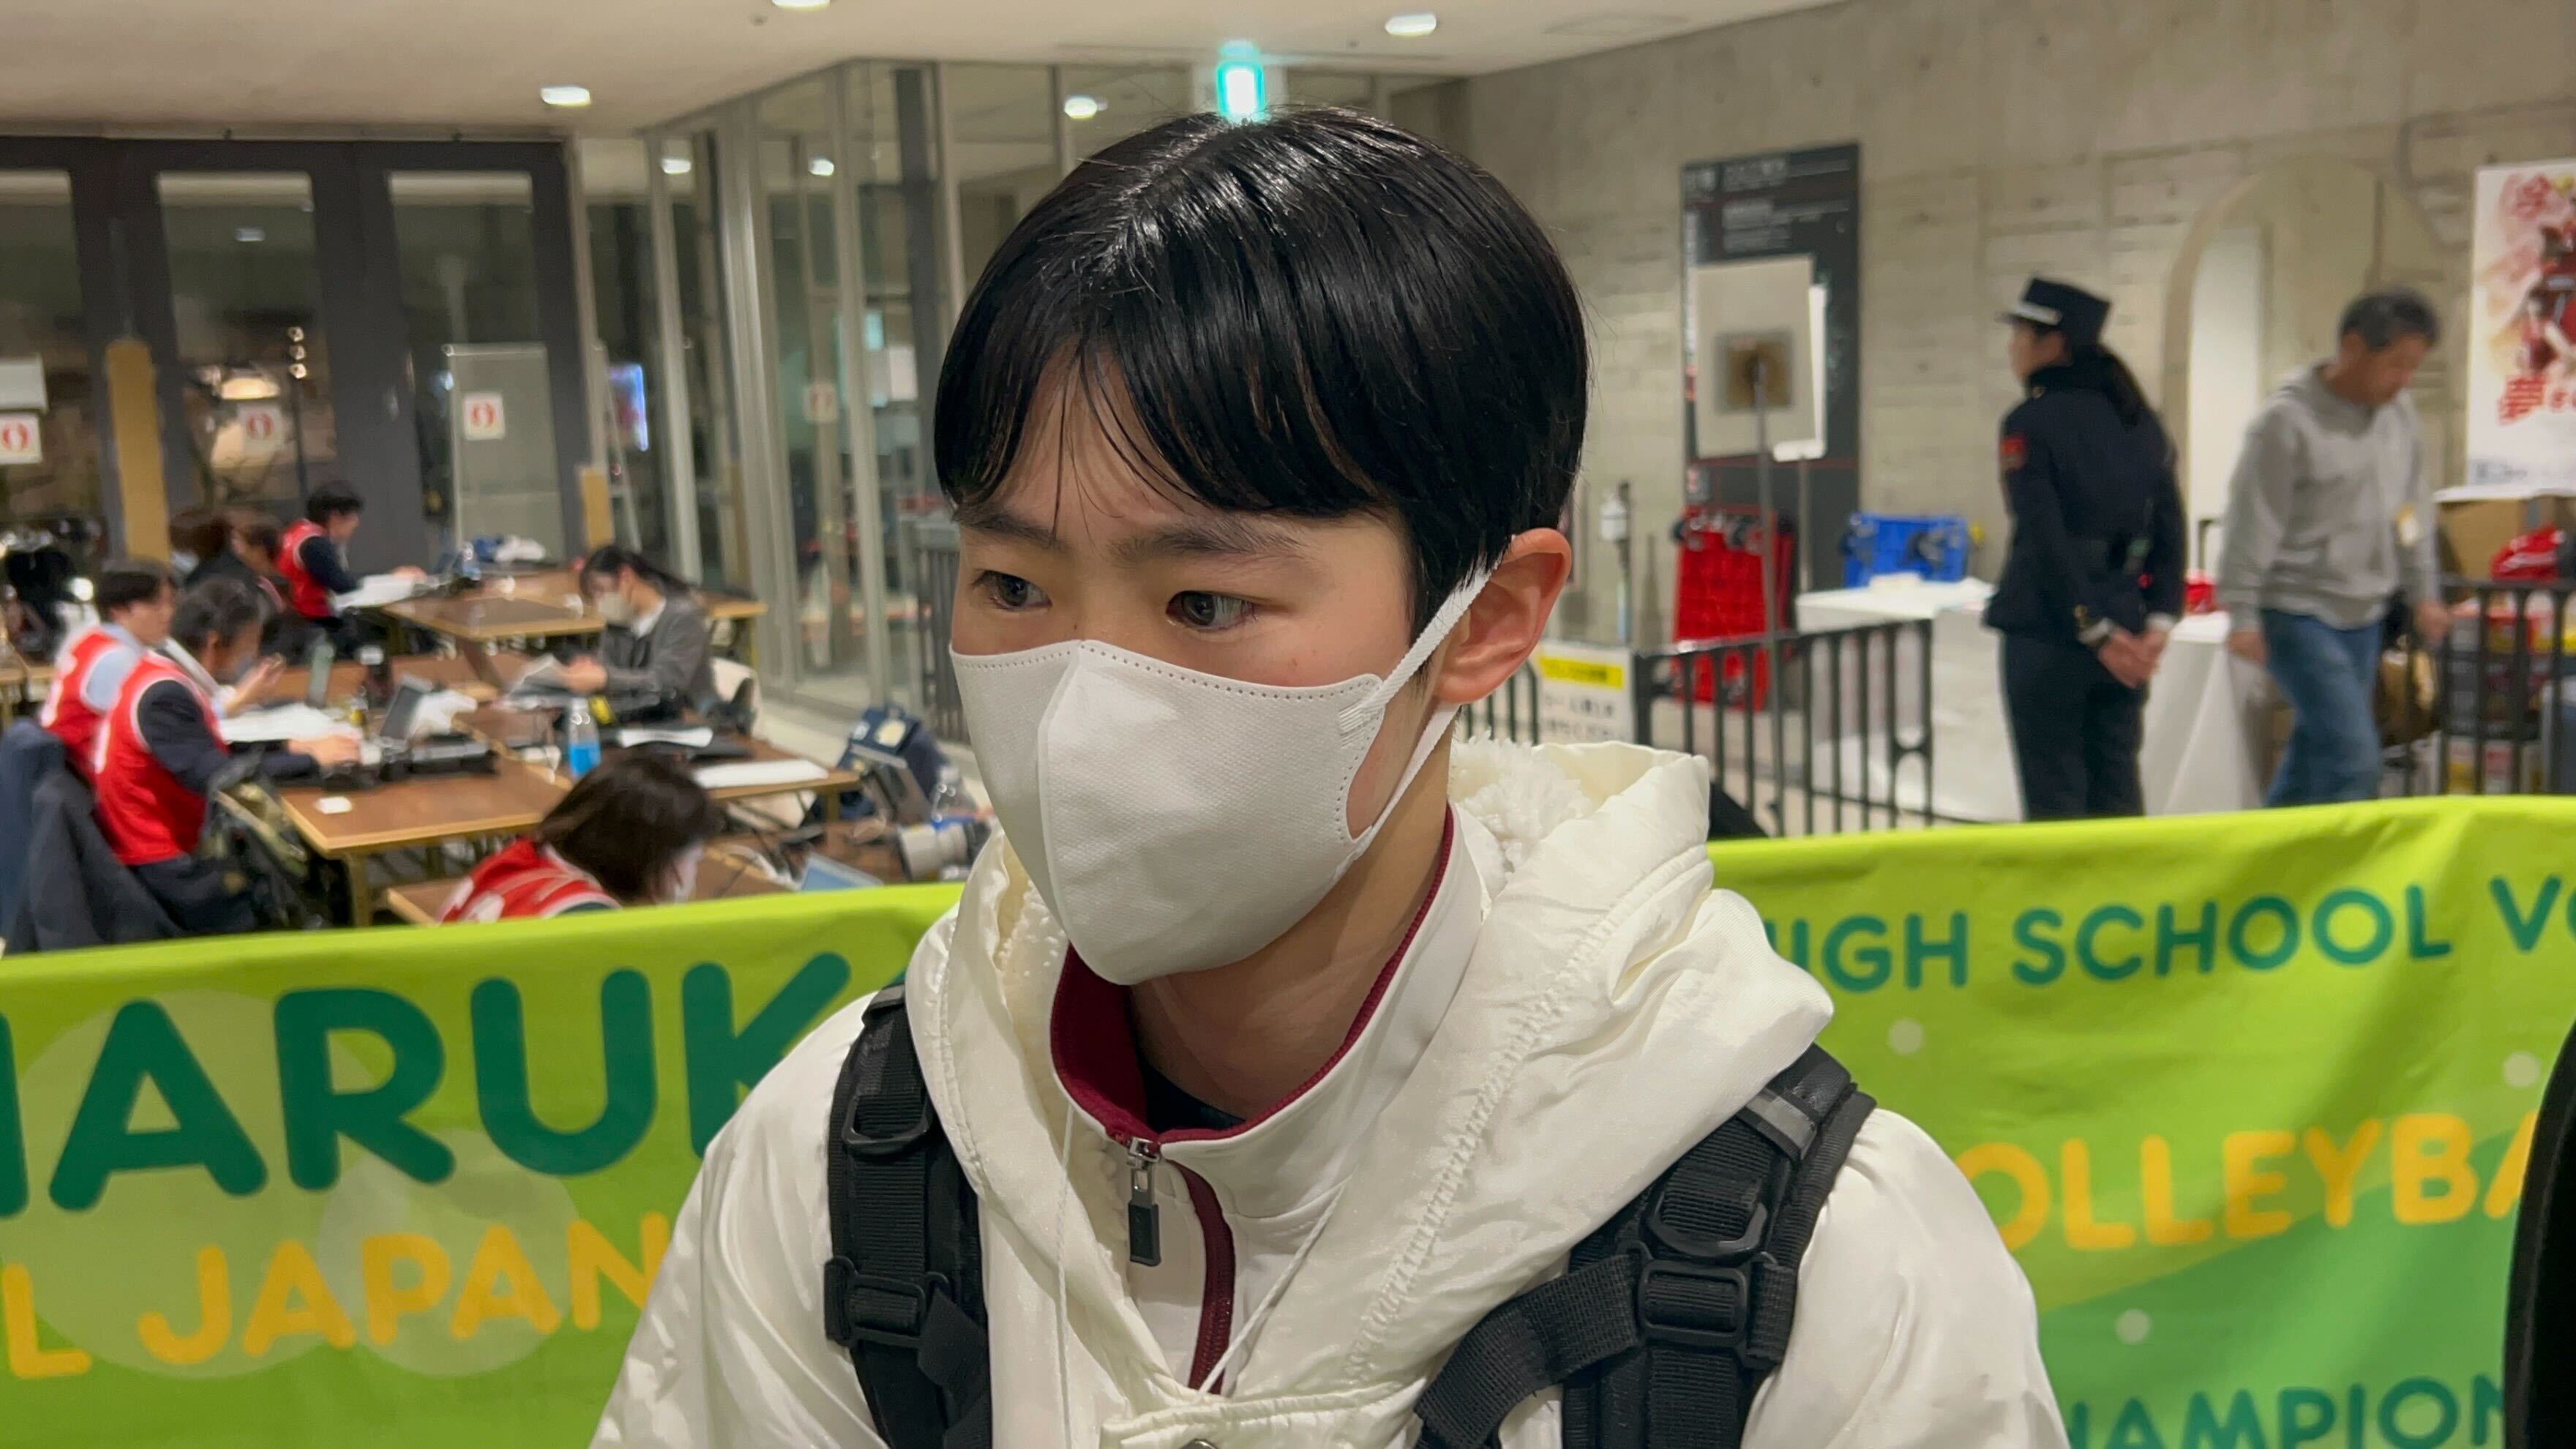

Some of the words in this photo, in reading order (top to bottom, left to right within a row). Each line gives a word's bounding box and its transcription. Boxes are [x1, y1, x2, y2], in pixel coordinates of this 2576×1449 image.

[1763, 910, 1969, 993] IGH
[2012, 884, 2452, 986] SCHOOL
[2490, 874, 2576, 954] V
[0, 951, 905, 1218] ARUK
[139, 1211, 669, 1366] JAPAN
[2055, 1374, 2504, 1449] AMPIO
